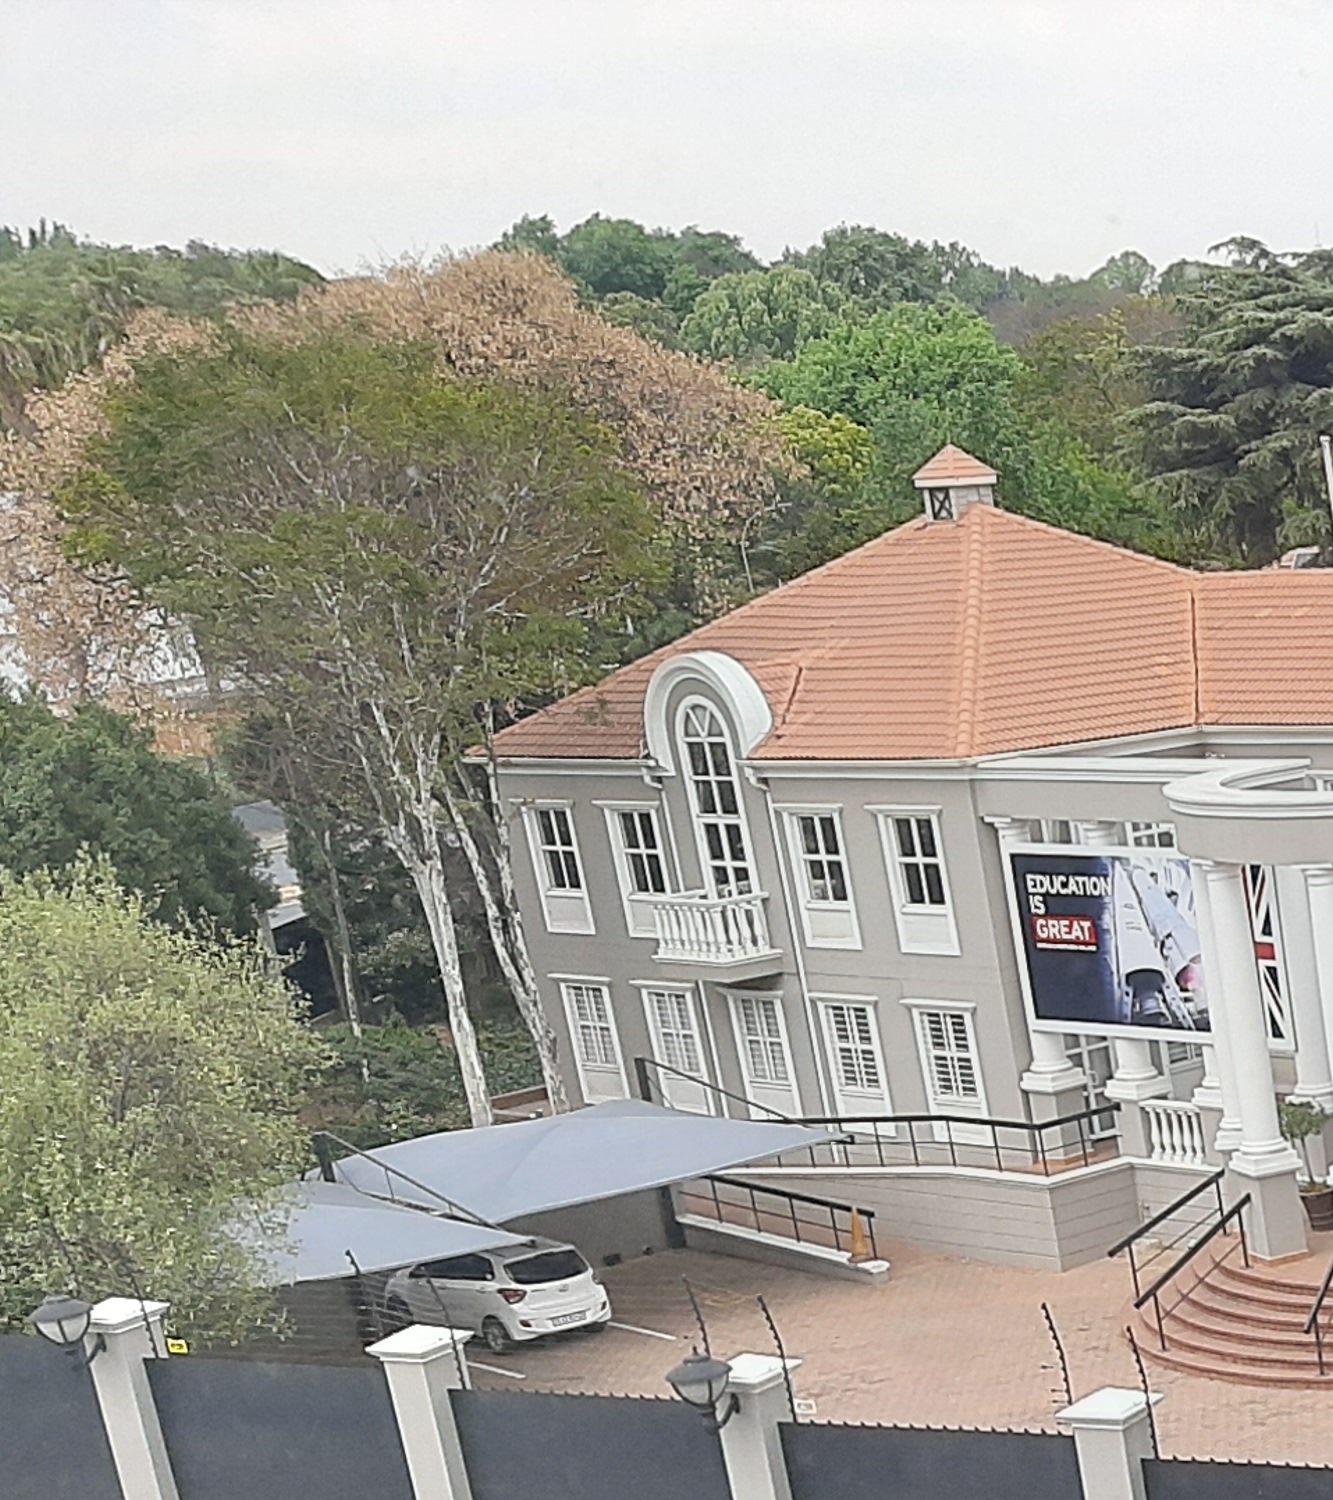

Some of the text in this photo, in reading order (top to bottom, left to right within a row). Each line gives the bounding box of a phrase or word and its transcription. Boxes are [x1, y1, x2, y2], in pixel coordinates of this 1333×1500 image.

[1025, 873, 1112, 896] EDUCATION
[1029, 895, 1046, 915] IS
[1036, 918, 1092, 941] GREAT
